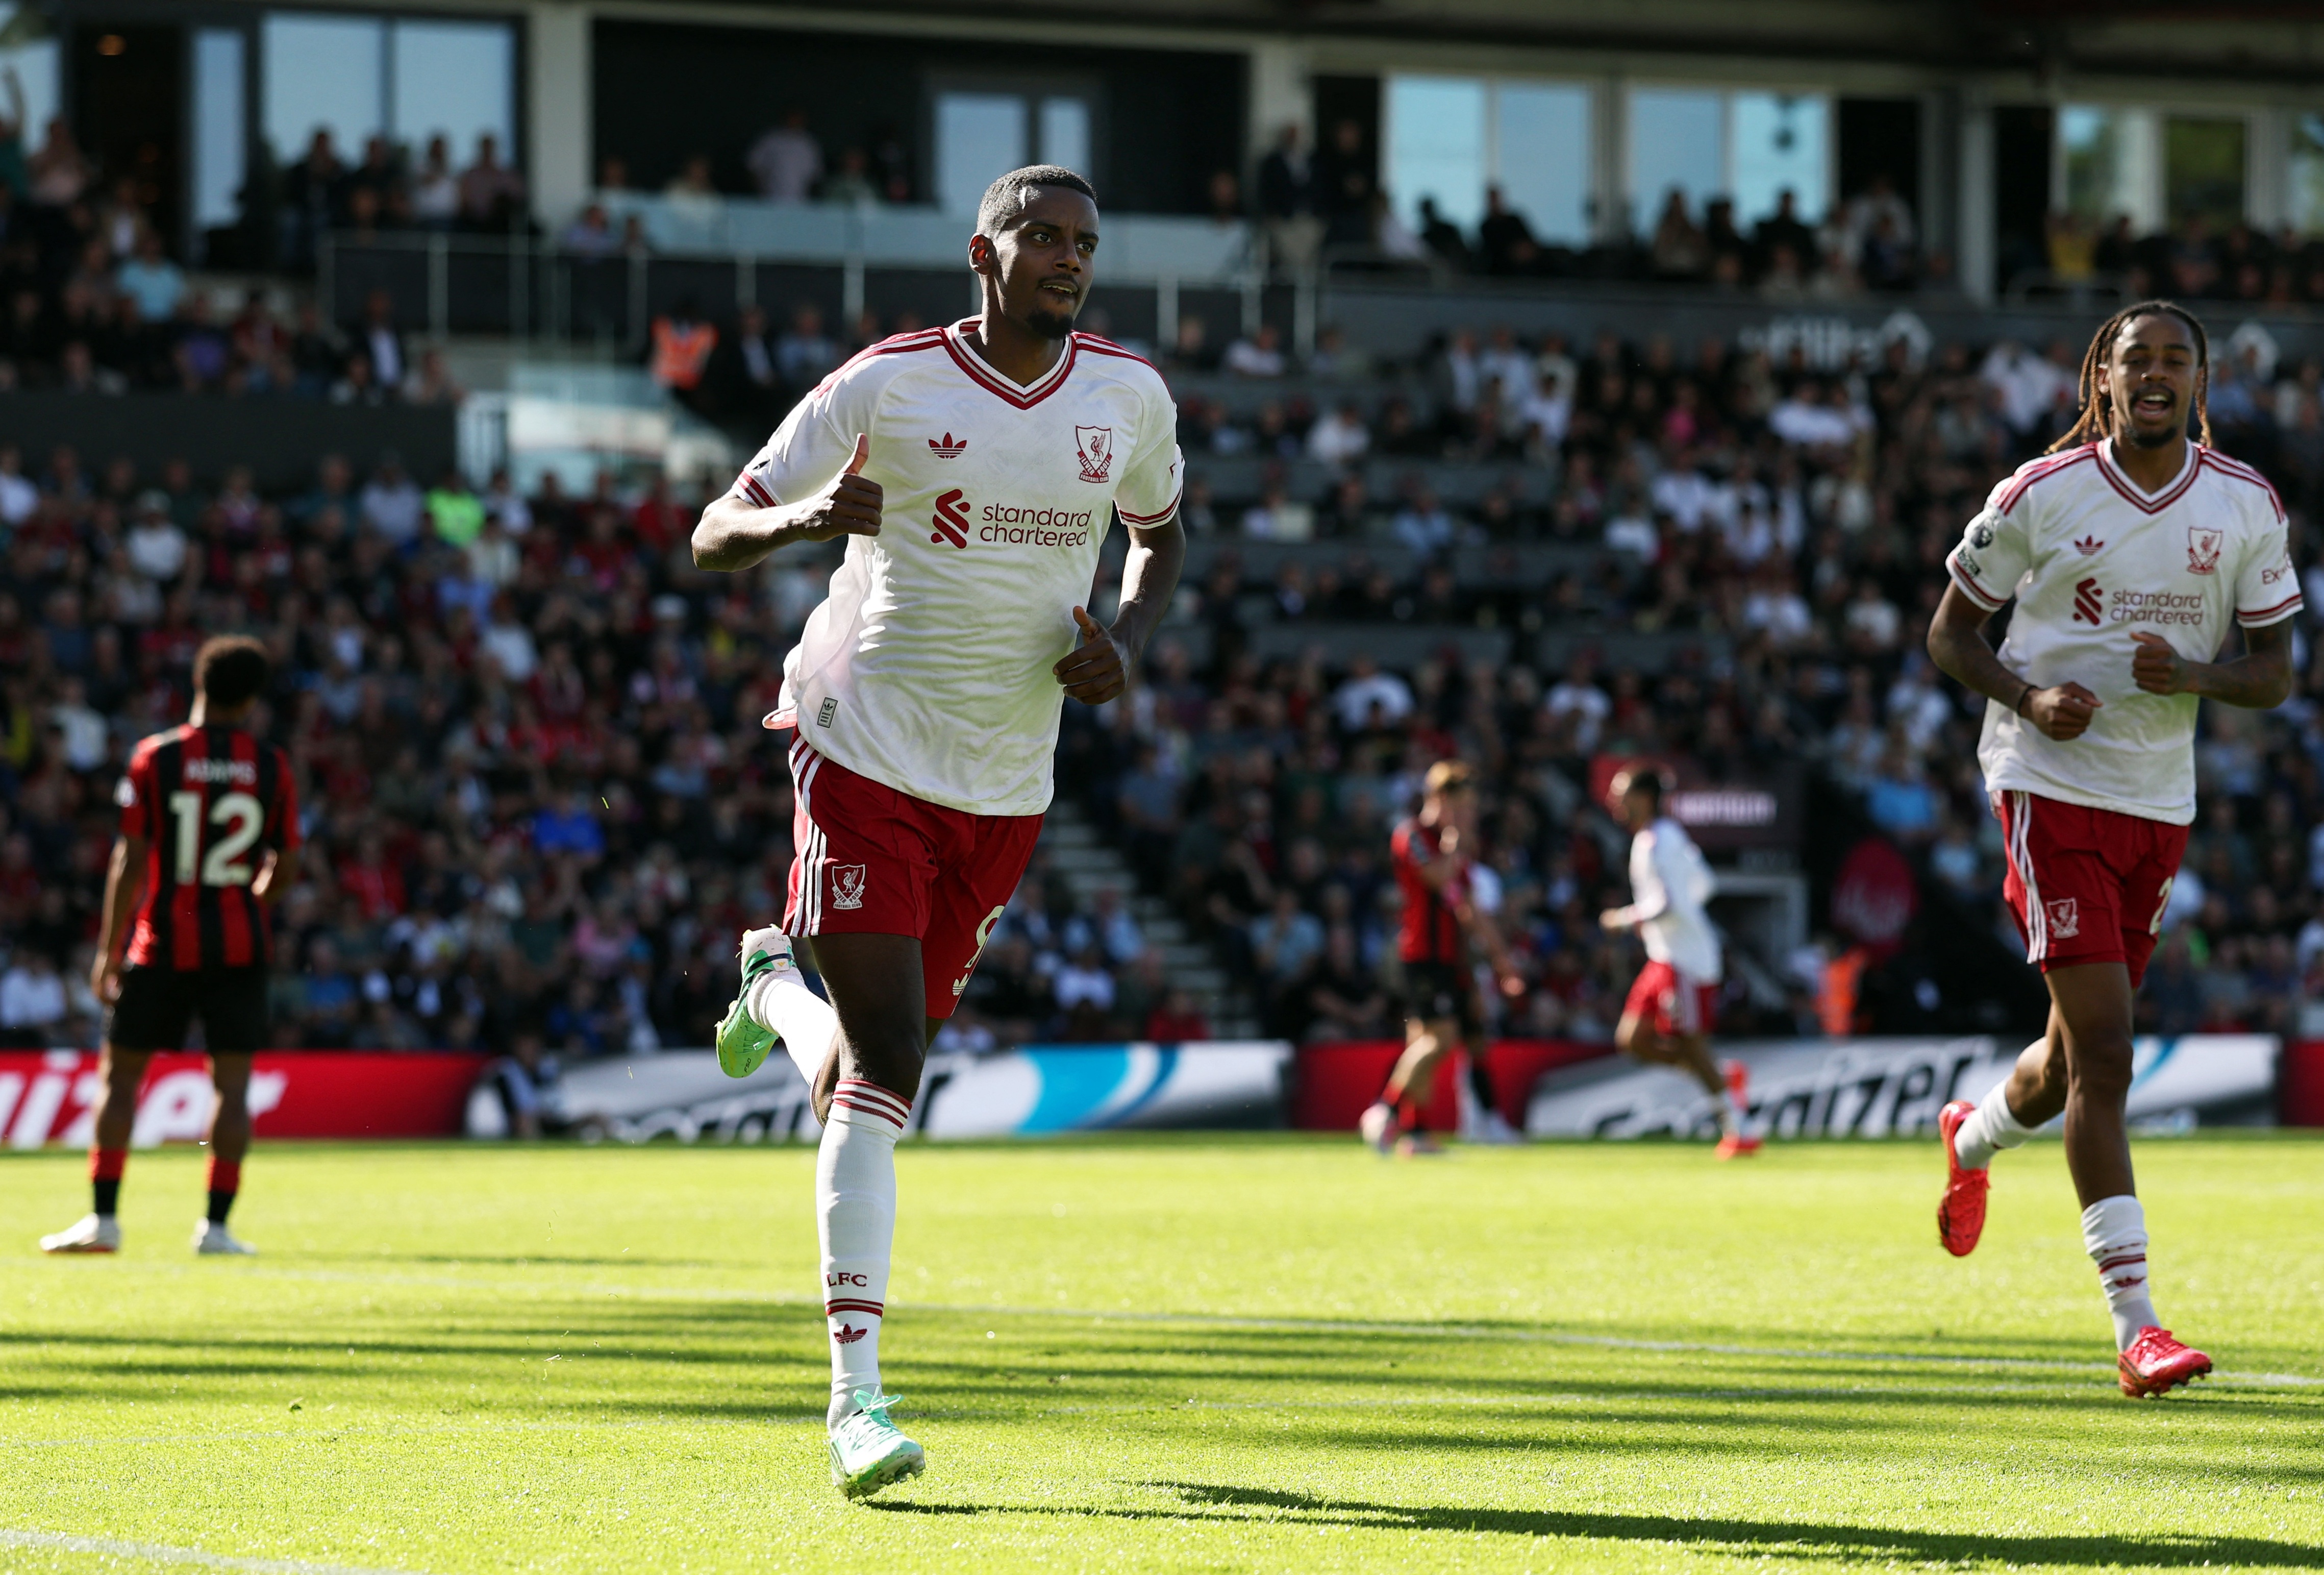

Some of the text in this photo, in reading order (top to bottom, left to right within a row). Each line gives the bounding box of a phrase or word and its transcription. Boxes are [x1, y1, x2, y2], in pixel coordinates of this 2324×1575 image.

[1081, 457, 1110, 476] LIVER POOL
[1080, 474, 1099, 482] FOOTBALL
[982, 503, 1092, 527] standard
[980, 524, 1089, 547] chartered
[2112, 589, 2202, 609] standard
[2110, 606, 2204, 625] chartered
[183, 756, 257, 785] ADAMS
[169, 791, 264, 887] 12
[835, 890, 861, 903] LIVER POOL
[827, 1272, 867, 1287] LFC
